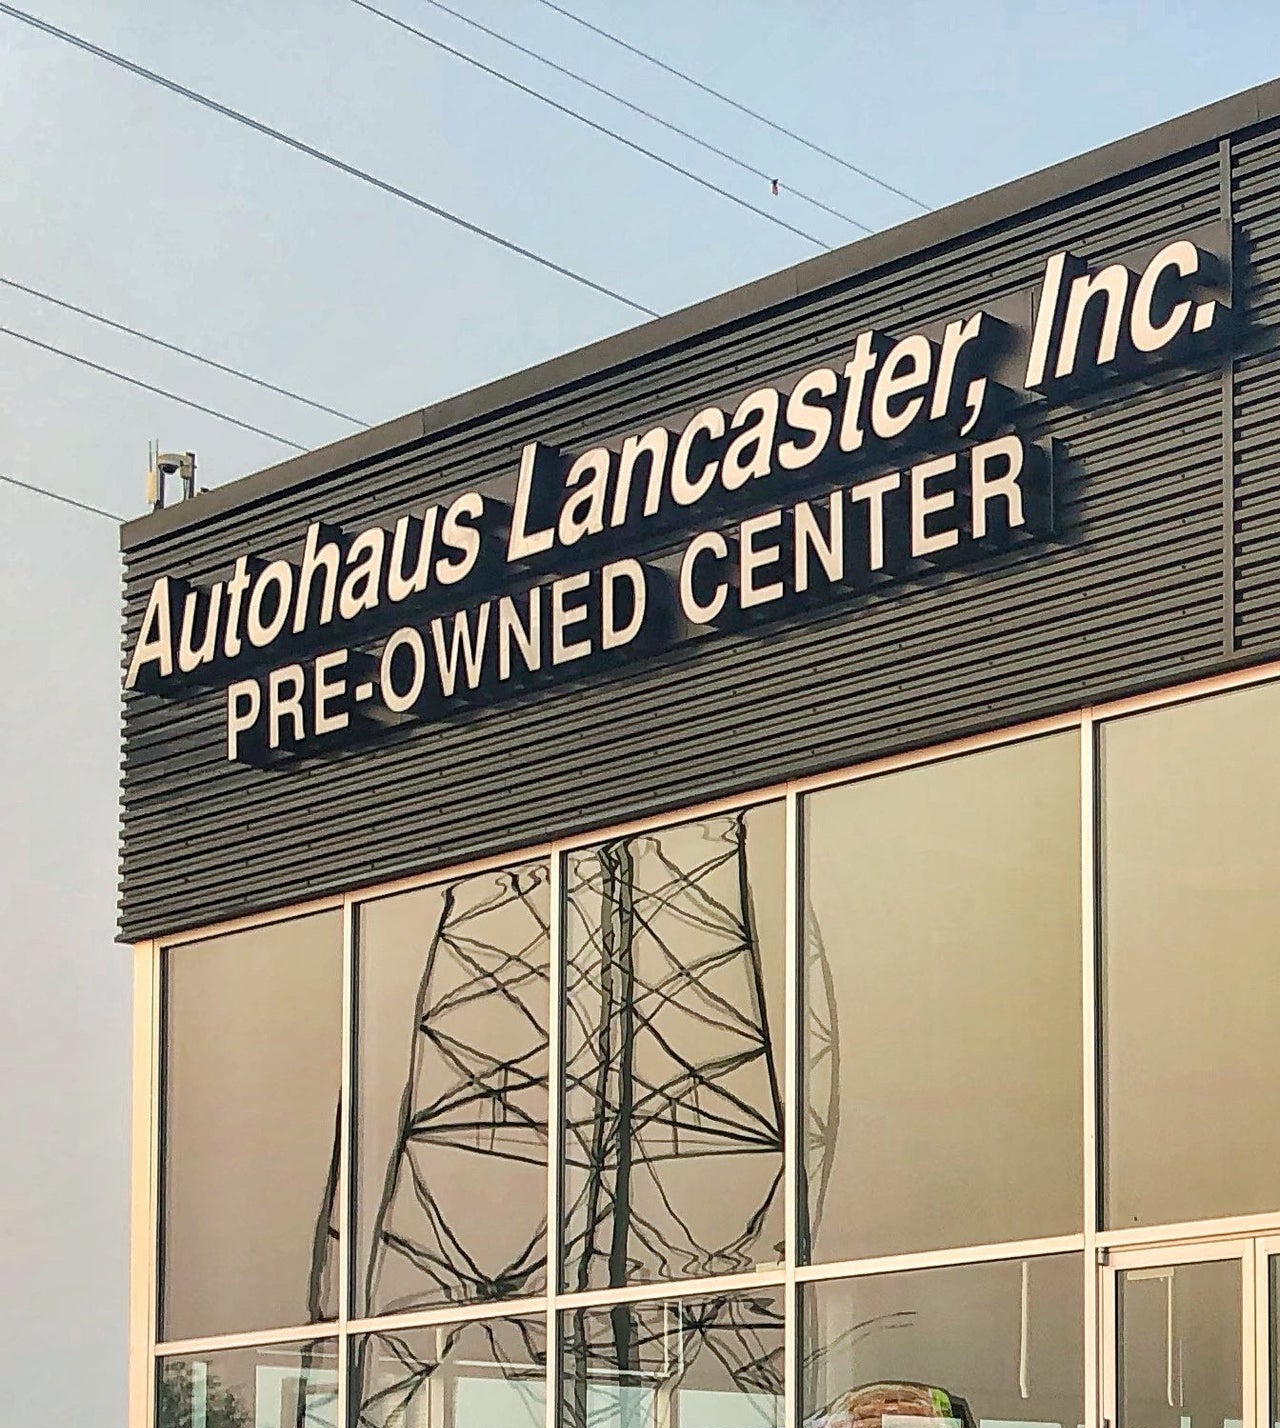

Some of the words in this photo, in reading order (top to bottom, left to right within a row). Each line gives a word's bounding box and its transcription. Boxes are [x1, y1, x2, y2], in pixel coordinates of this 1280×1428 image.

[124, 491, 484, 690] Autohaus
[506, 310, 988, 562] Lancaster,
[1023, 239, 1217, 389] Inc.
[227, 557, 647, 761] PRE-OWNED
[679, 434, 1026, 625] CENTER
